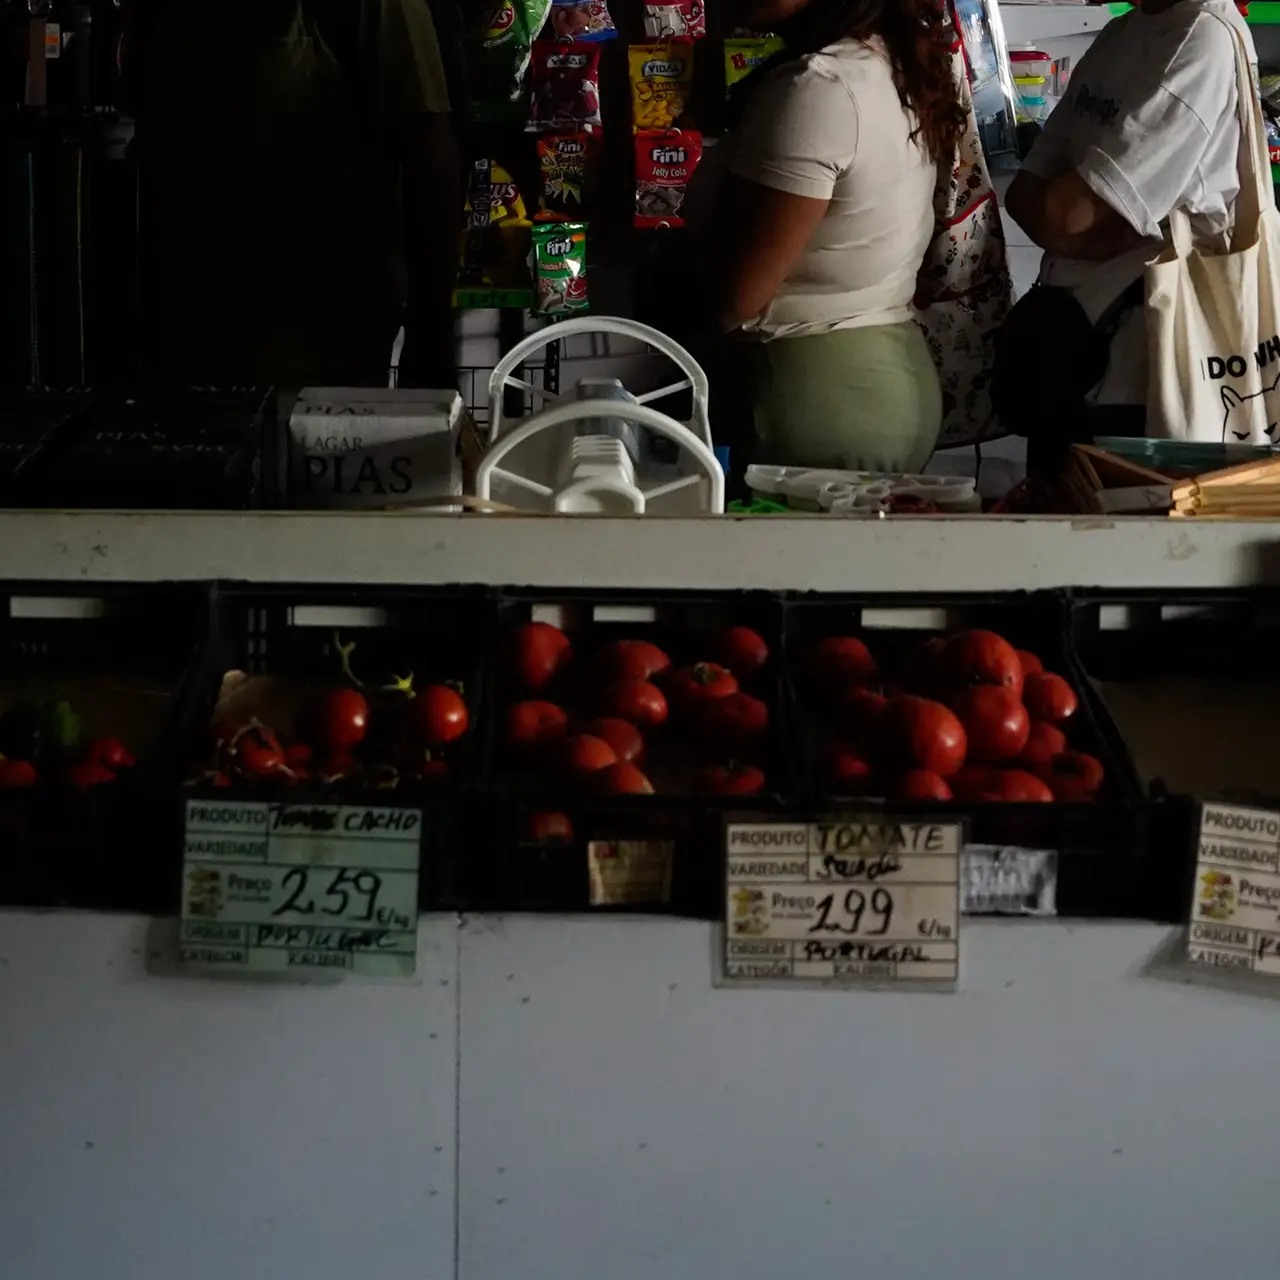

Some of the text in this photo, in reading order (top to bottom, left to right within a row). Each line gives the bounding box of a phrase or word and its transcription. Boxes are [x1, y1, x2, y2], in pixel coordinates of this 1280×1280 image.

[648, 64, 680, 74] VIDAL
[557, 140, 583, 154] Fini
[652, 147, 685, 165] Fini
[651, 166, 687, 178] Jelly Cola
[546, 237, 571, 255] Fini
[301, 455, 413, 494] PIAS
[190, 807, 266, 824] PRODUTO
[1204, 811, 1279, 834] PRODUTO
[730, 824, 945, 852] PRODUTO TOMATE
[227, 873, 272, 894] Preço
[772, 891, 816, 910] Preço
